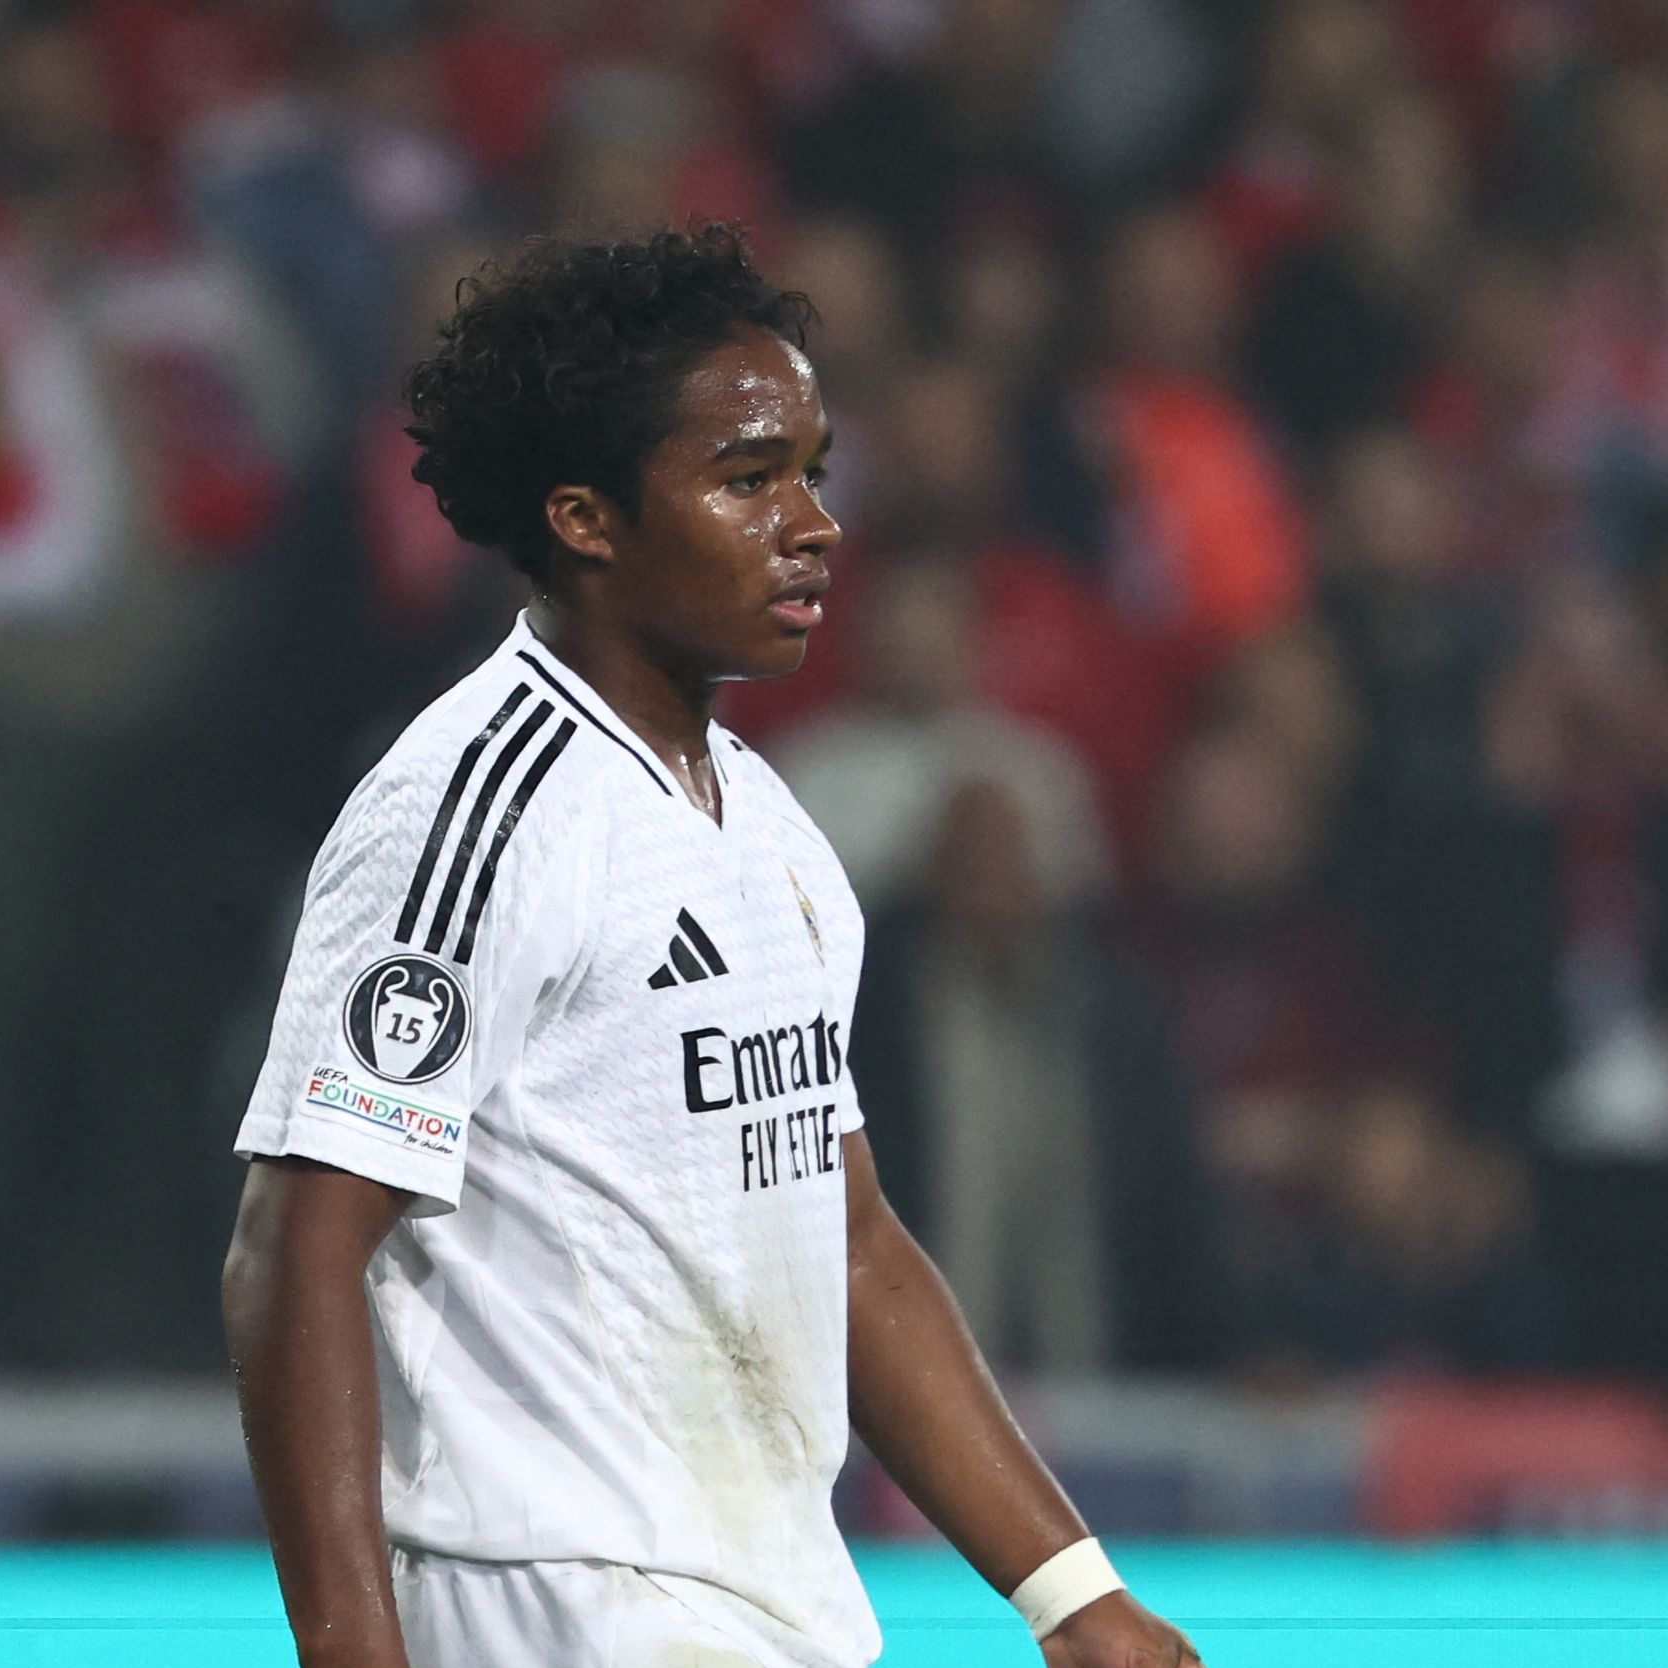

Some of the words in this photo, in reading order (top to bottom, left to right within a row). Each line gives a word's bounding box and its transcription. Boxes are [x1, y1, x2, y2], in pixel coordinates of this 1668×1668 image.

[385, 1012, 424, 1045] 15
[313, 1066, 349, 1083] UEFA
[307, 1079, 461, 1142] FOUNDATION
[403, 1132, 419, 1144] for
[741, 1117, 778, 1193] FLY
